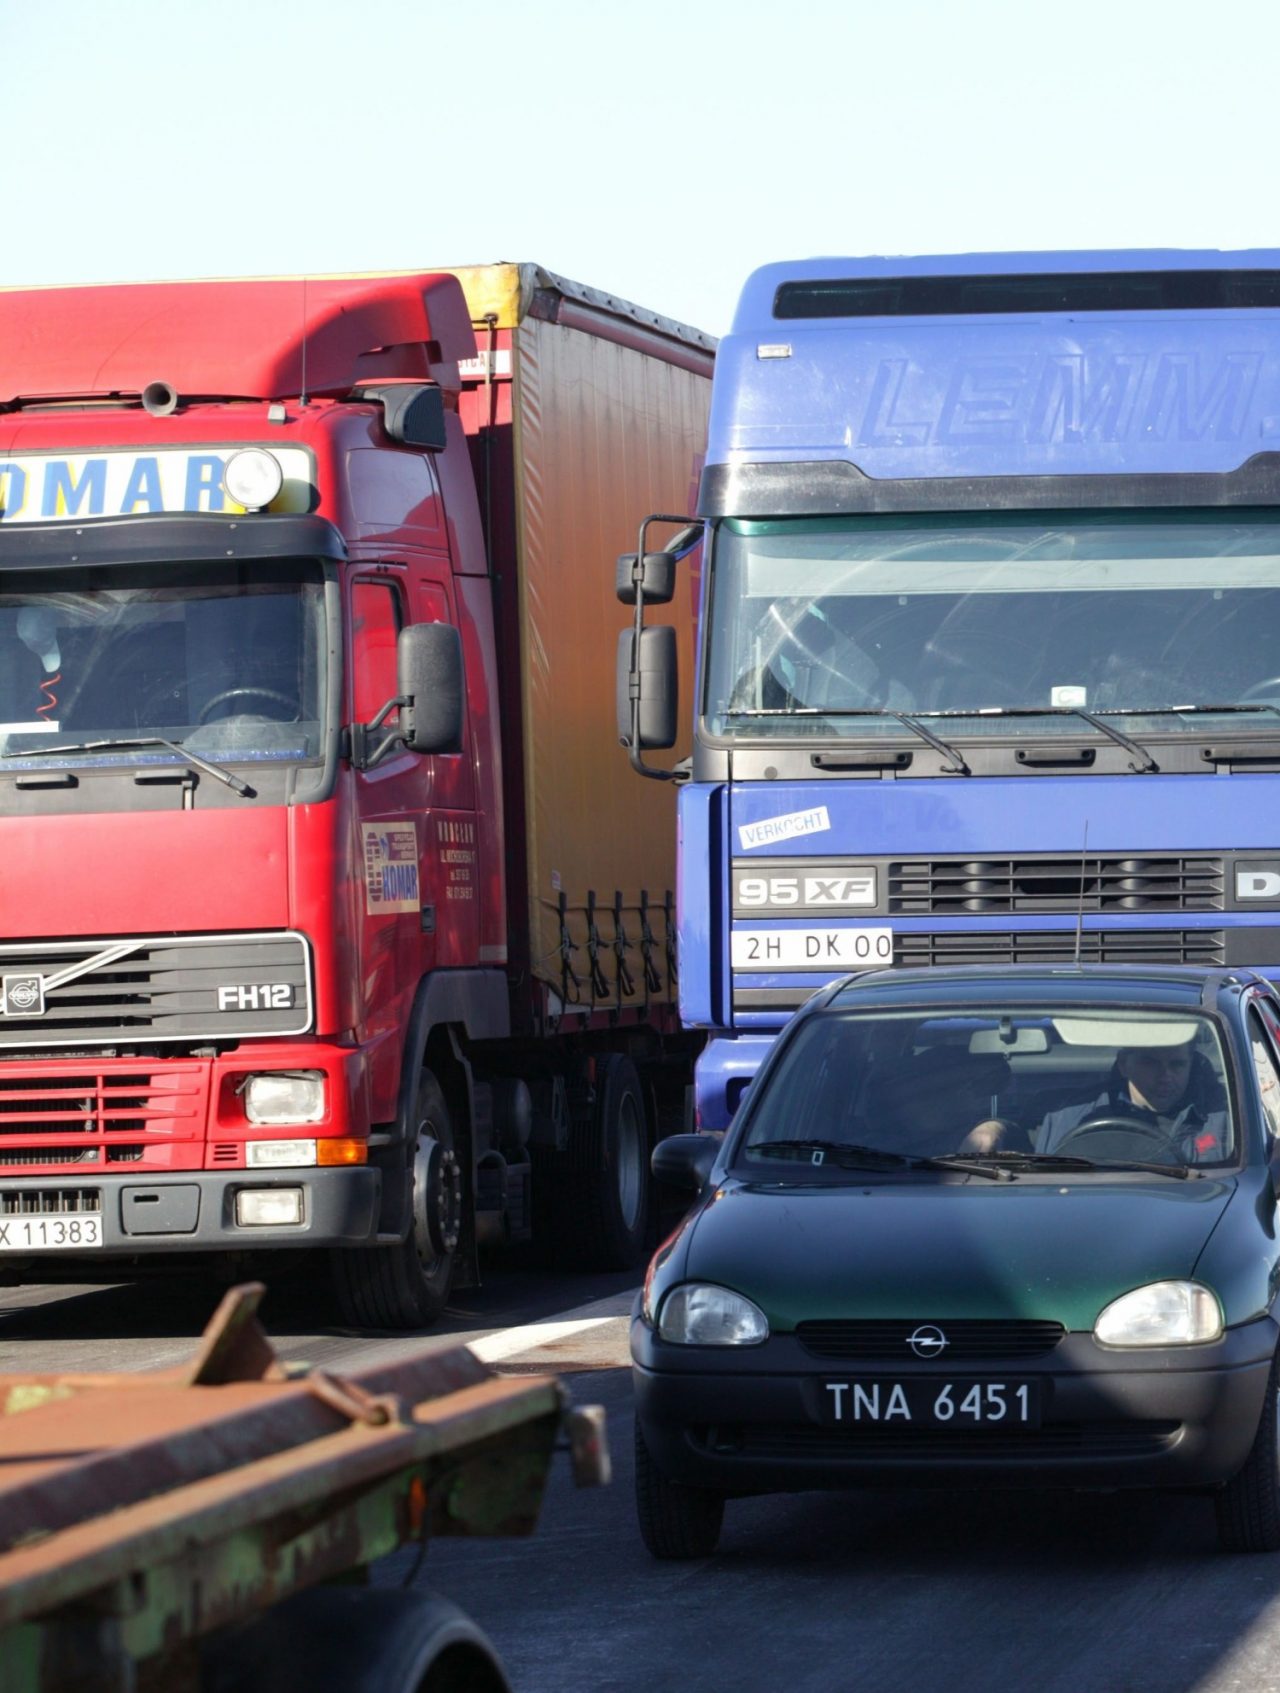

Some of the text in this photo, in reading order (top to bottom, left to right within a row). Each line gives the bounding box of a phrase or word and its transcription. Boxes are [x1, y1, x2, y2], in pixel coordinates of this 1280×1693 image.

[218, 984, 292, 1011] FH12
[23, 1220, 97, 1246] 11383
[826, 1383, 1028, 1422] TNA 6451
